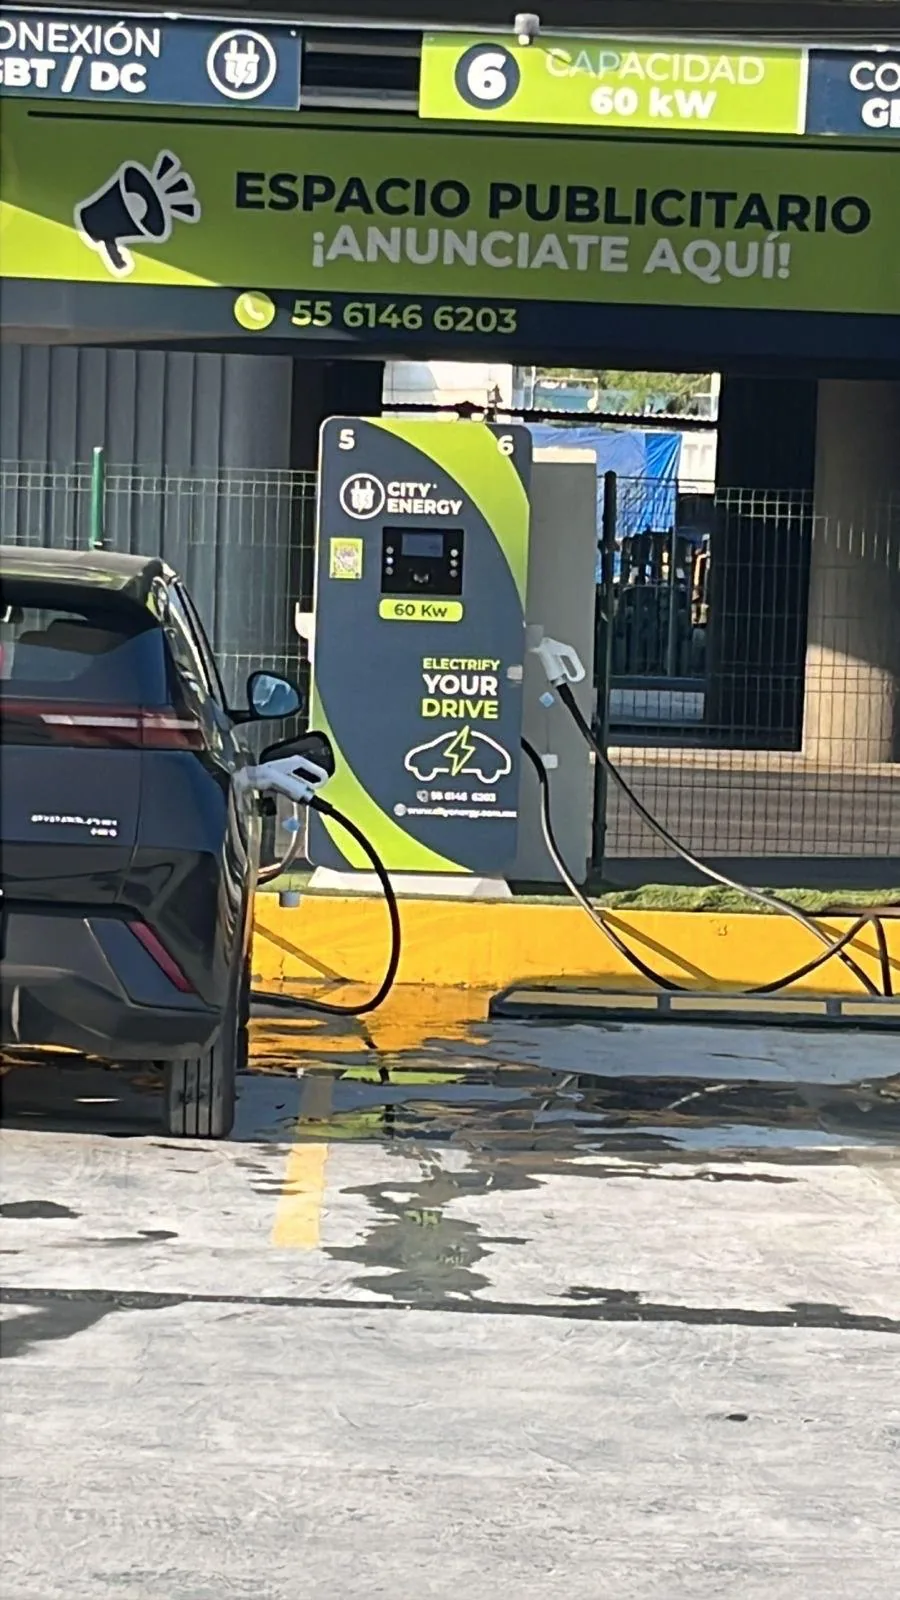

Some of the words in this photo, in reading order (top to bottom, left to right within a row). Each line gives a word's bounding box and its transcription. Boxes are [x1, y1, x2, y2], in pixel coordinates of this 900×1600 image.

[0, 57, 56, 88] BT
[61, 57, 83, 93] /
[90, 62, 147, 94] DC
[467, 52, 506, 101] 6
[545, 47, 765, 86] CAPACIDAD
[589, 86, 638, 116] 60
[649, 86, 718, 118] kW
[235, 171, 470, 218] ESPACIO
[488, 181, 871, 235] PUBLICITARIO
[312, 224, 629, 274] ¡ANUNCIATE
[643, 231, 791, 285] AQUÍ!
[291, 299, 332, 327] 55
[342, 302, 423, 330] 6146
[433, 305, 517, 333] 6203
[338, 429, 355, 450] 5
[497, 435, 514, 456] 6
[387, 481, 431, 498] CITY
[387, 498, 463, 516] ENERGY
[394, 603, 416, 617] 60
[421, 603, 448, 618] Kw
[422, 658, 500, 672] ELECTRIFY
[422, 674, 498, 697] YOUR
[421, 698, 499, 720] DRIVE
